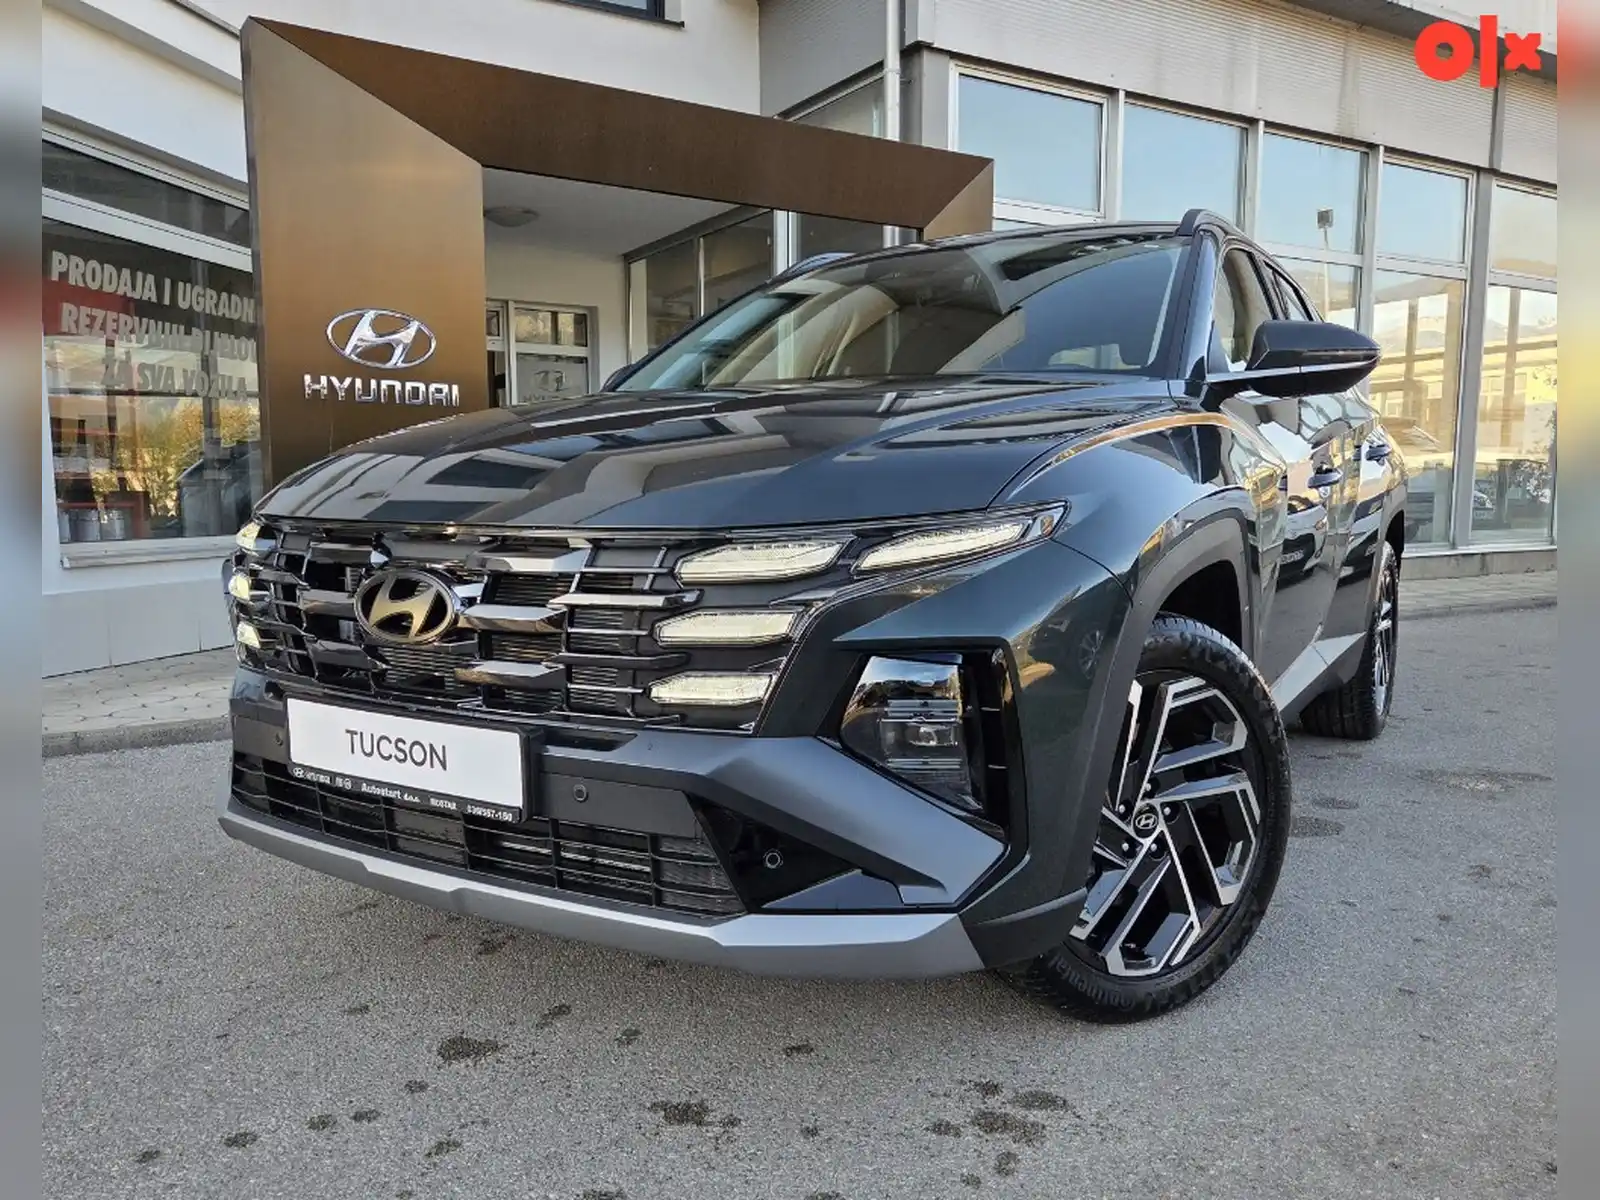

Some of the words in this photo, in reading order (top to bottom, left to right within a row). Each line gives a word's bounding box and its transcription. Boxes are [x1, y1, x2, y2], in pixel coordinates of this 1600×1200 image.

[51, 250, 157, 302] PRODAJA
[163, 277, 171, 305] I
[137, 362, 177, 394] SVA
[303, 373, 459, 407] HYUNDAI
[345, 729, 448, 771] TUCSON
[361, 782, 401, 799] Autostart
[1048, 954, 1136, 1012] Continental
